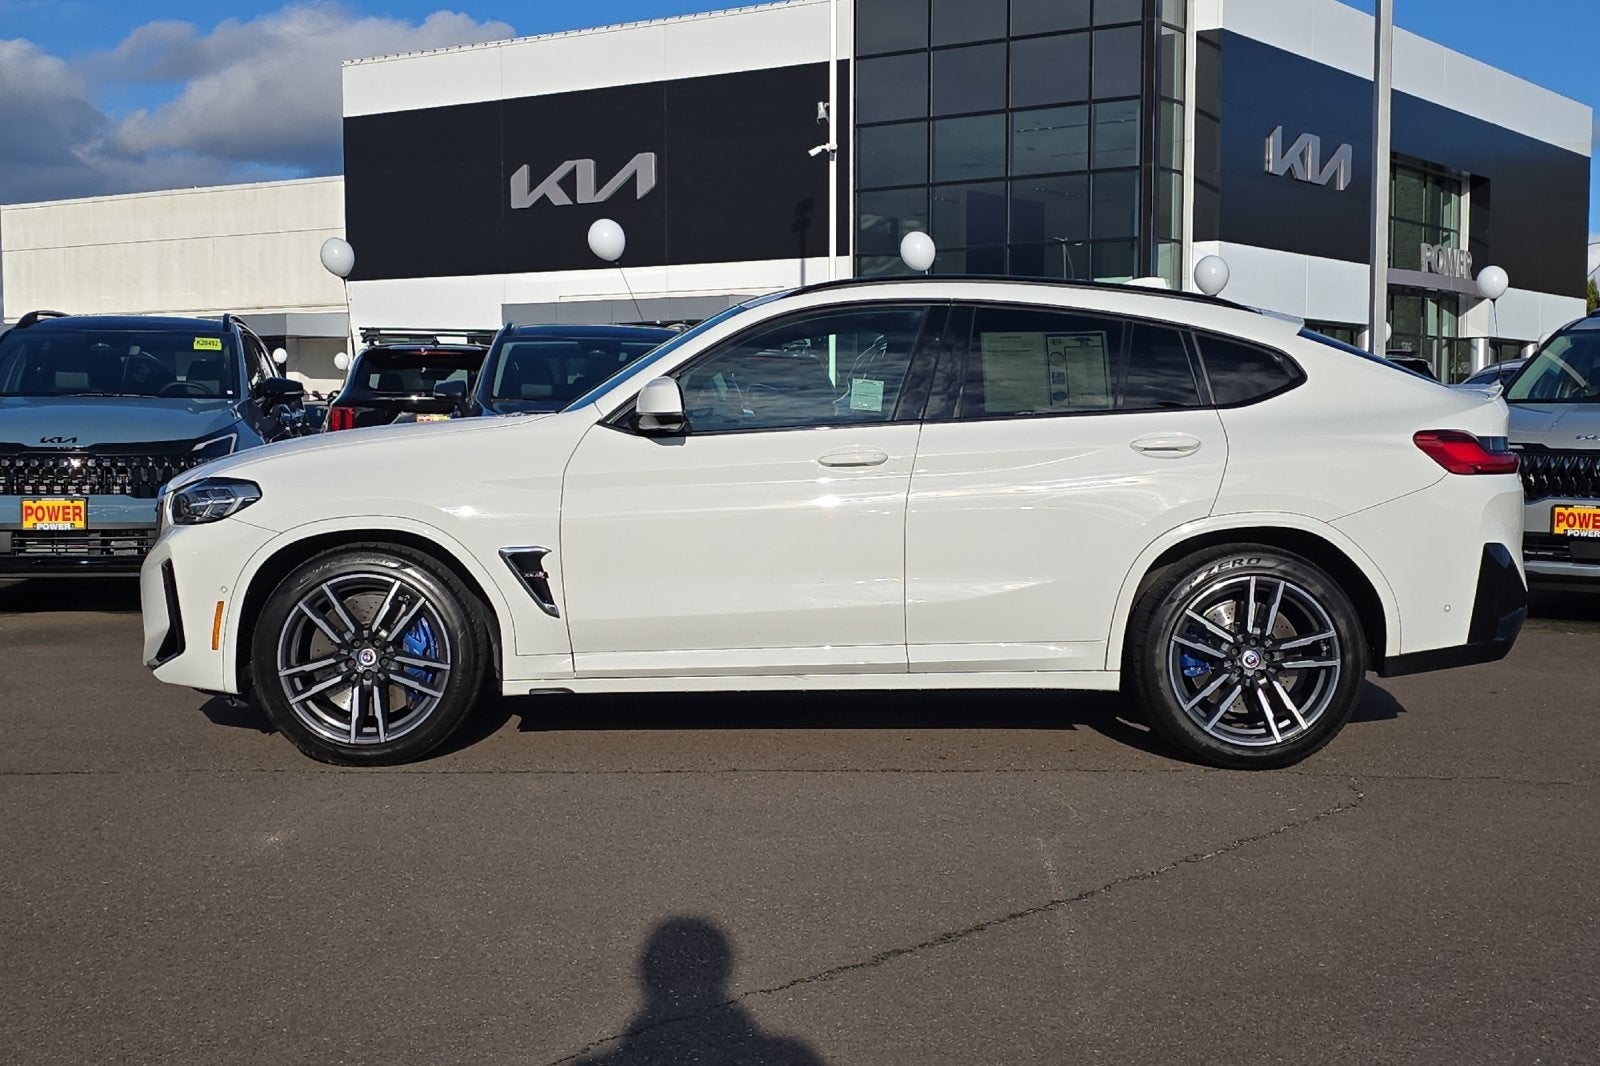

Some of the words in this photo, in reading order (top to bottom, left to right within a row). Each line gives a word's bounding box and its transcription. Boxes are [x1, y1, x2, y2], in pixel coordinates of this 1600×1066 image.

[1265, 125, 1352, 191] KIA
[510, 152, 656, 209] KIA
[1421, 242, 1472, 280] POWER
[24, 505, 82, 522] POWER
[37, 523, 71, 531] POWER
